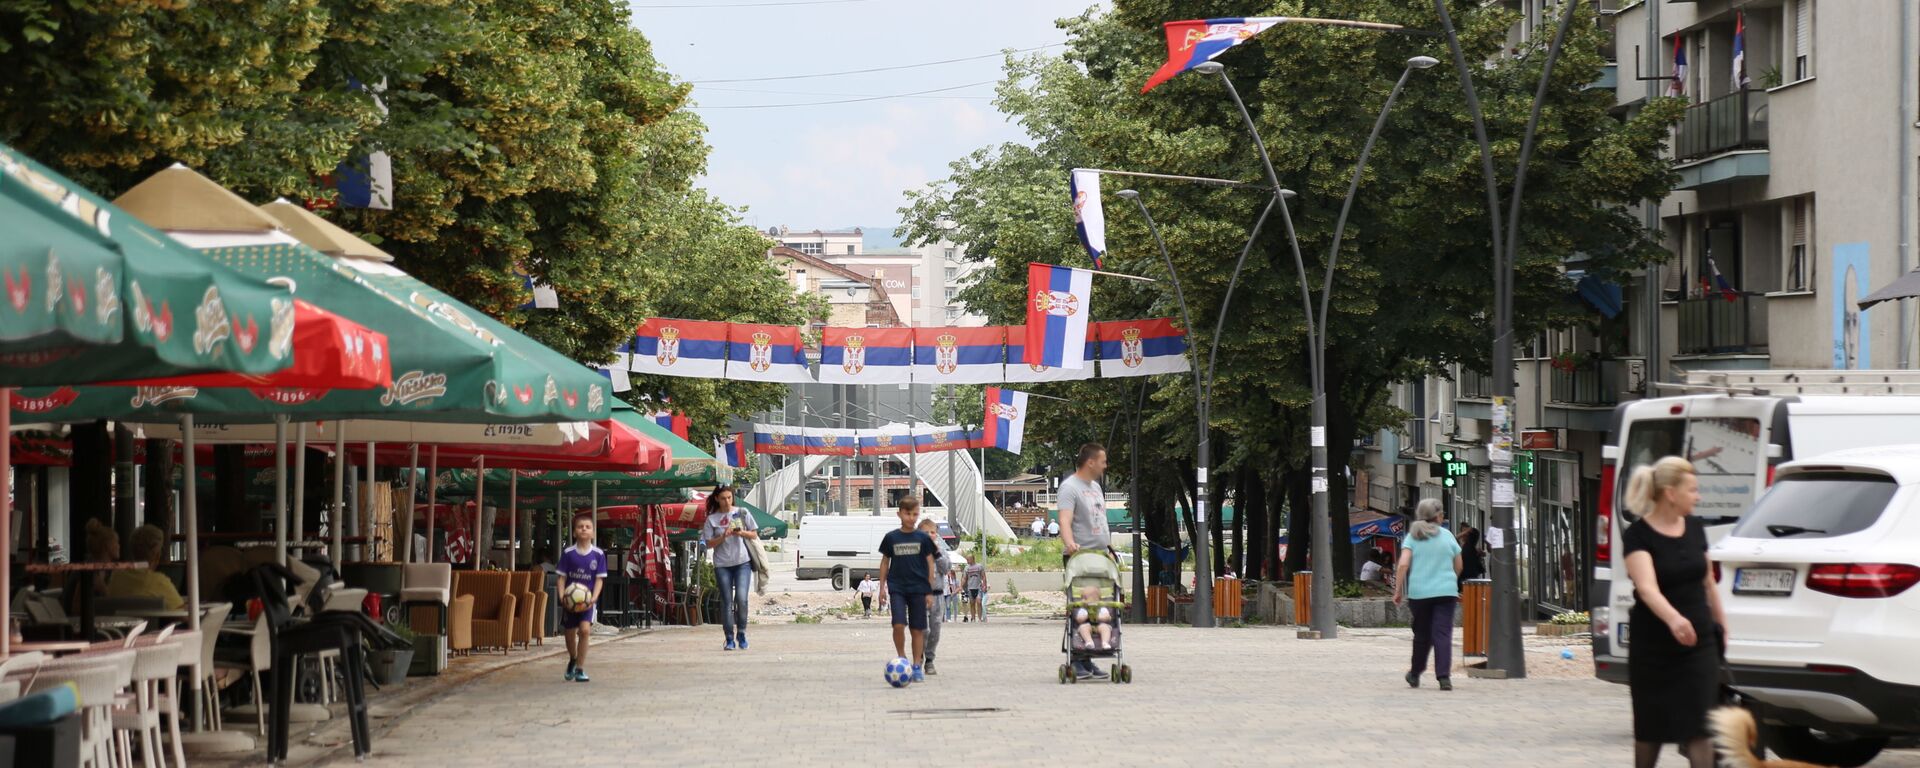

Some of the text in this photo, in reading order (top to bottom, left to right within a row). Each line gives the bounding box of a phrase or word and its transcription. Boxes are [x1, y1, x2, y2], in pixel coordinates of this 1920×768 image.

[885, 279, 906, 289] COM
[276, 391, 305, 402] 1896
[23, 398, 53, 410] 1896
[1447, 462, 1467, 476] PHI
